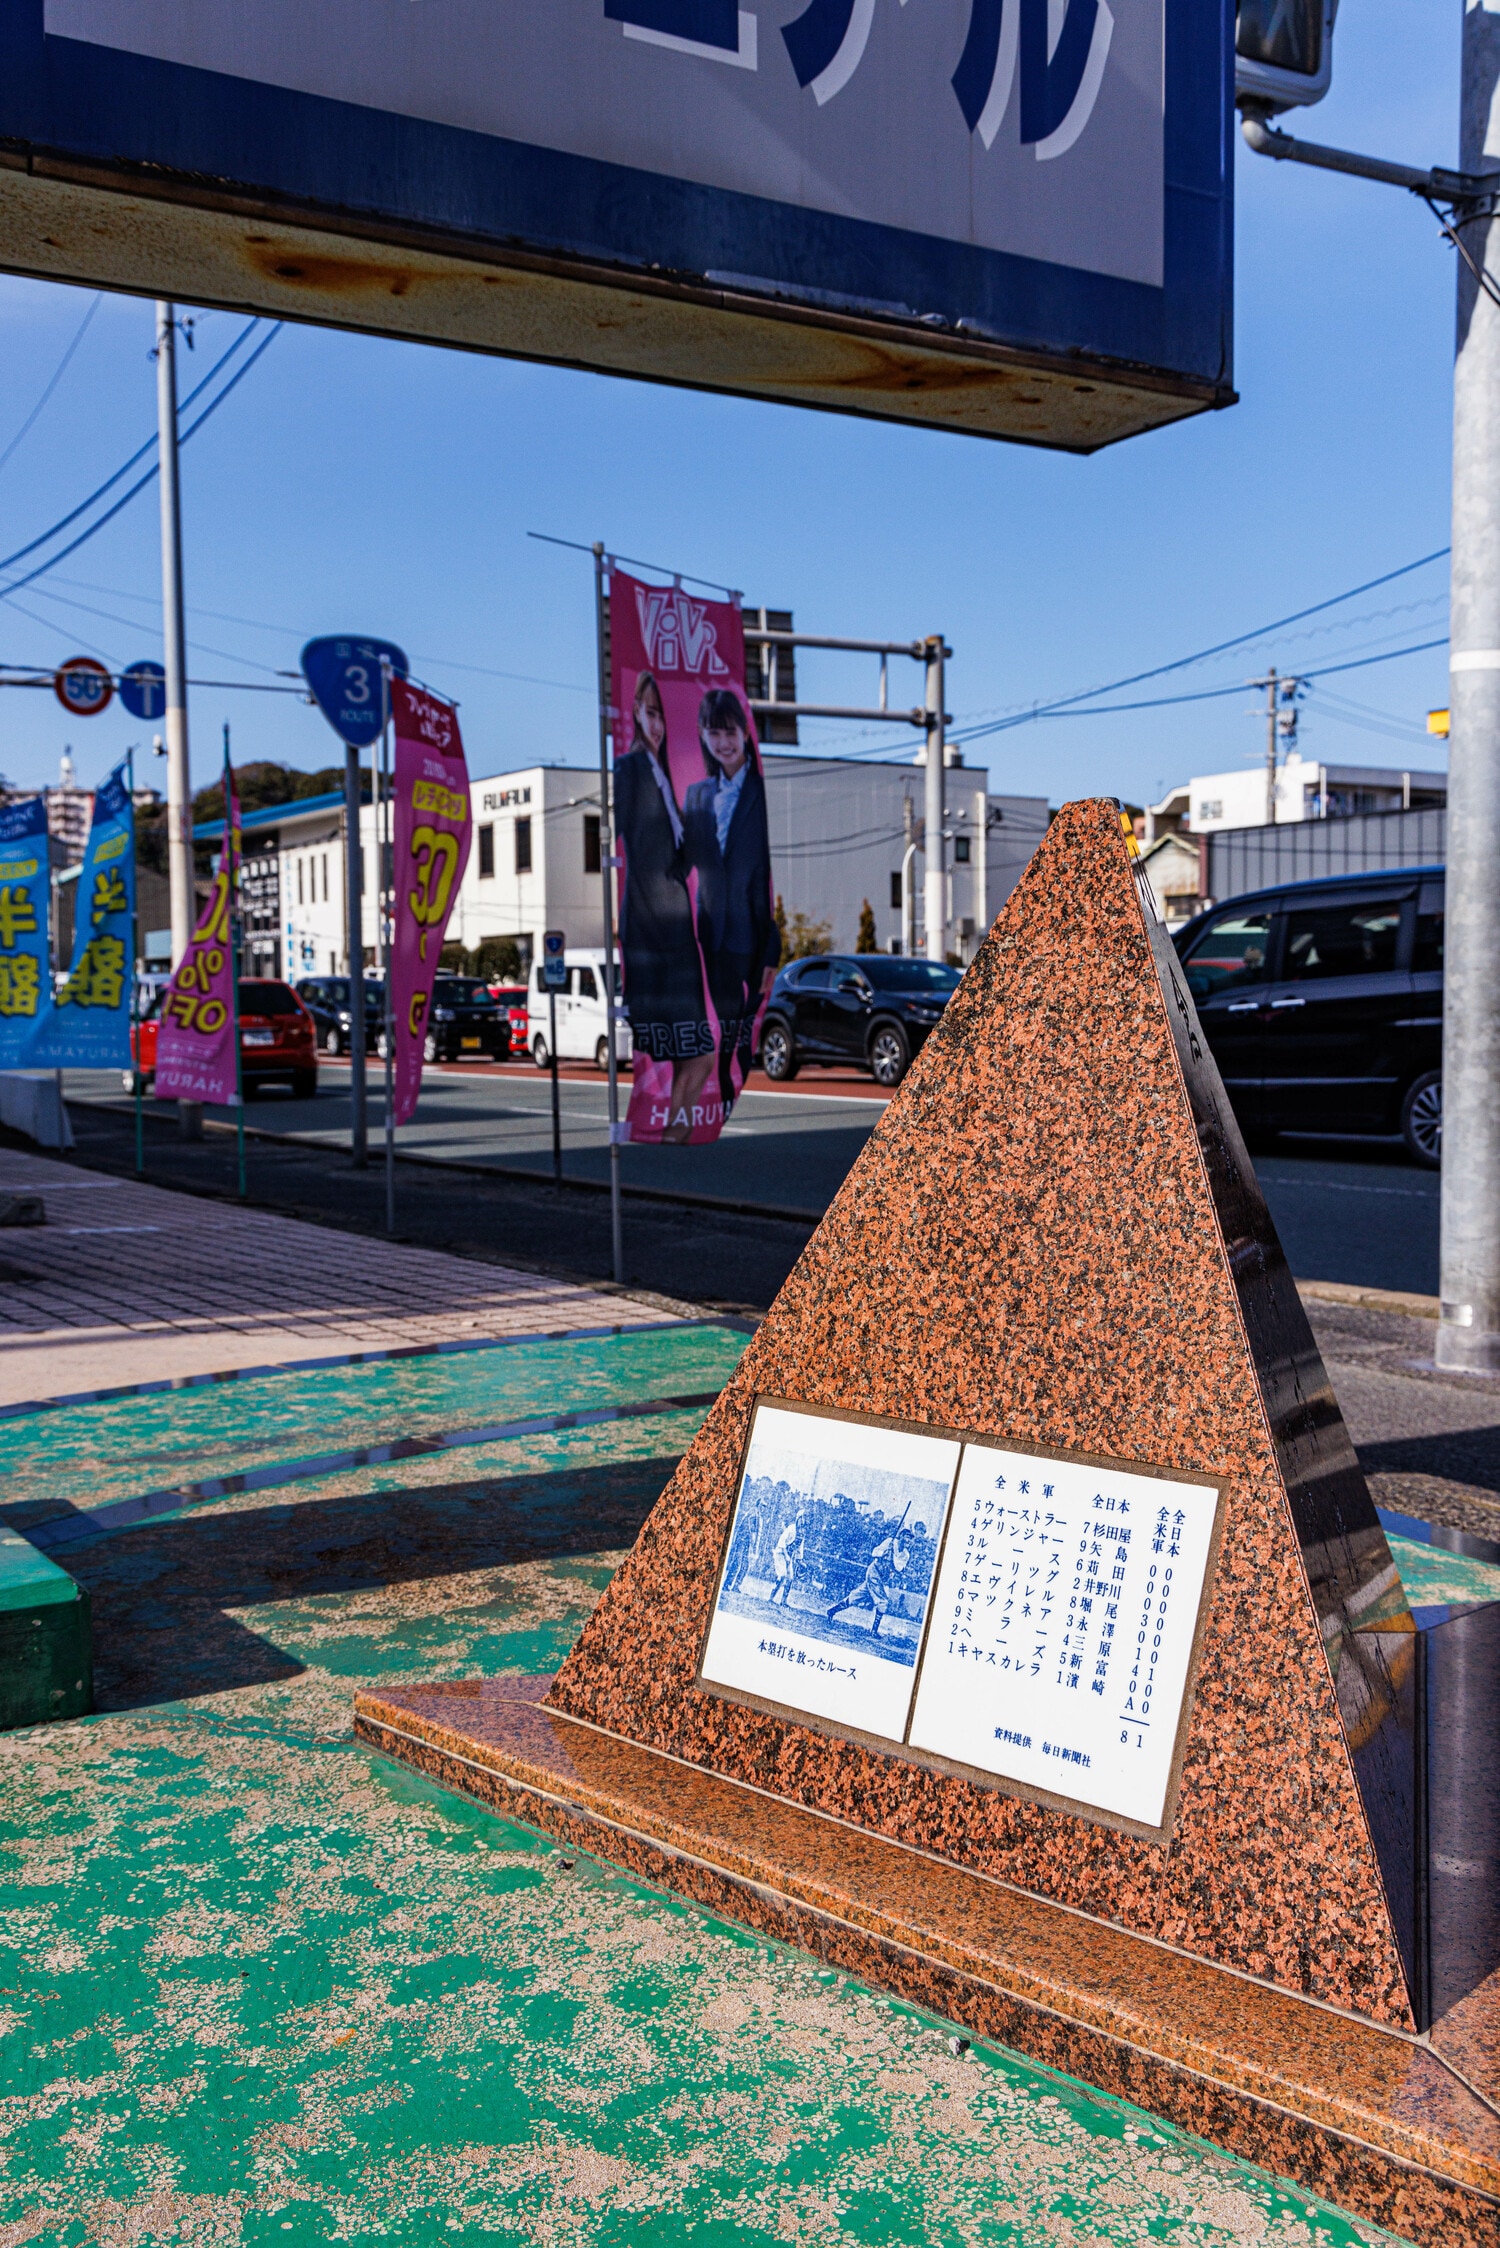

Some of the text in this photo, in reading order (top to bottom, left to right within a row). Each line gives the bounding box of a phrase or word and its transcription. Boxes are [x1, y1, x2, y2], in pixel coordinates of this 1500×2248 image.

[344, 664, 370, 703] 3
[340, 709, 376, 722] ROUTE
[410, 825, 459, 927] 30
[995, 1475, 1055, 1499] 全米軍
[1092, 1493, 1131, 1515] 全日本
[1151, 1506, 1170, 1554] 全米軍
[1167, 1509, 1187, 1558] 全日本
[758, 1639, 857, 1680] 本塁打を放ったルース
[1120, 1730, 1128, 1744] 8
